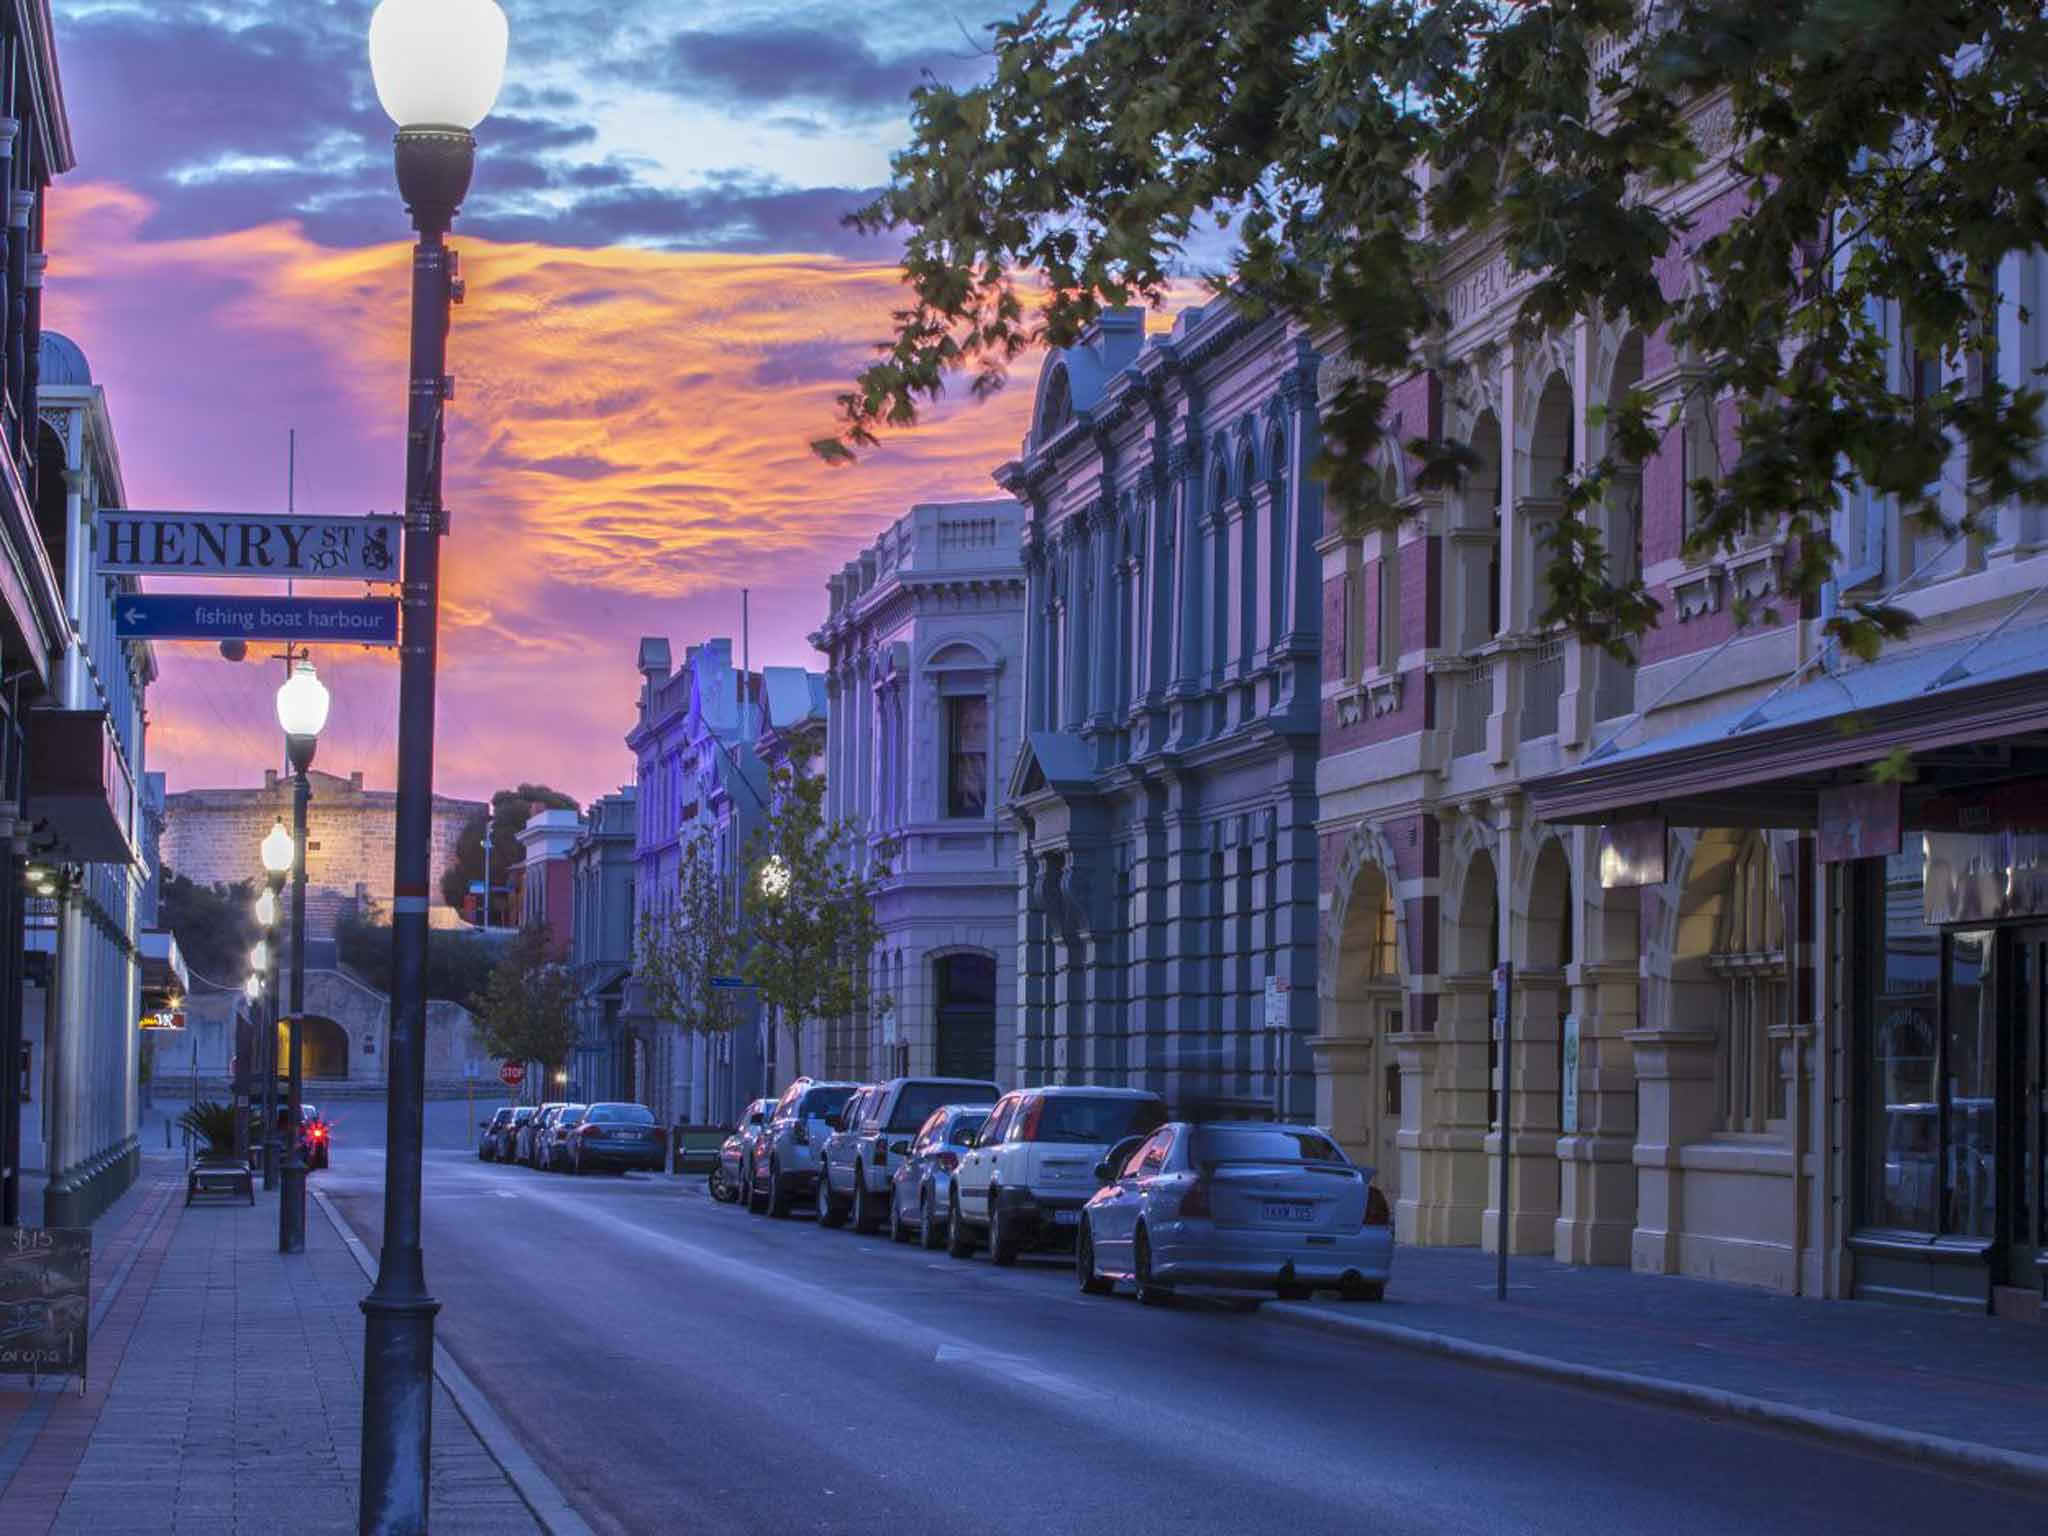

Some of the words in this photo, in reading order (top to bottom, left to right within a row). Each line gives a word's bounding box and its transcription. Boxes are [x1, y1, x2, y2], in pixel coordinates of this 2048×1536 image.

[103, 521, 317, 569] HENRY
[321, 527, 355, 547] ST
[195, 607, 255, 629] fishing
[260, 608, 302, 627] boat
[308, 610, 384, 628] harbour
[502, 1067, 522, 1078] STOP
